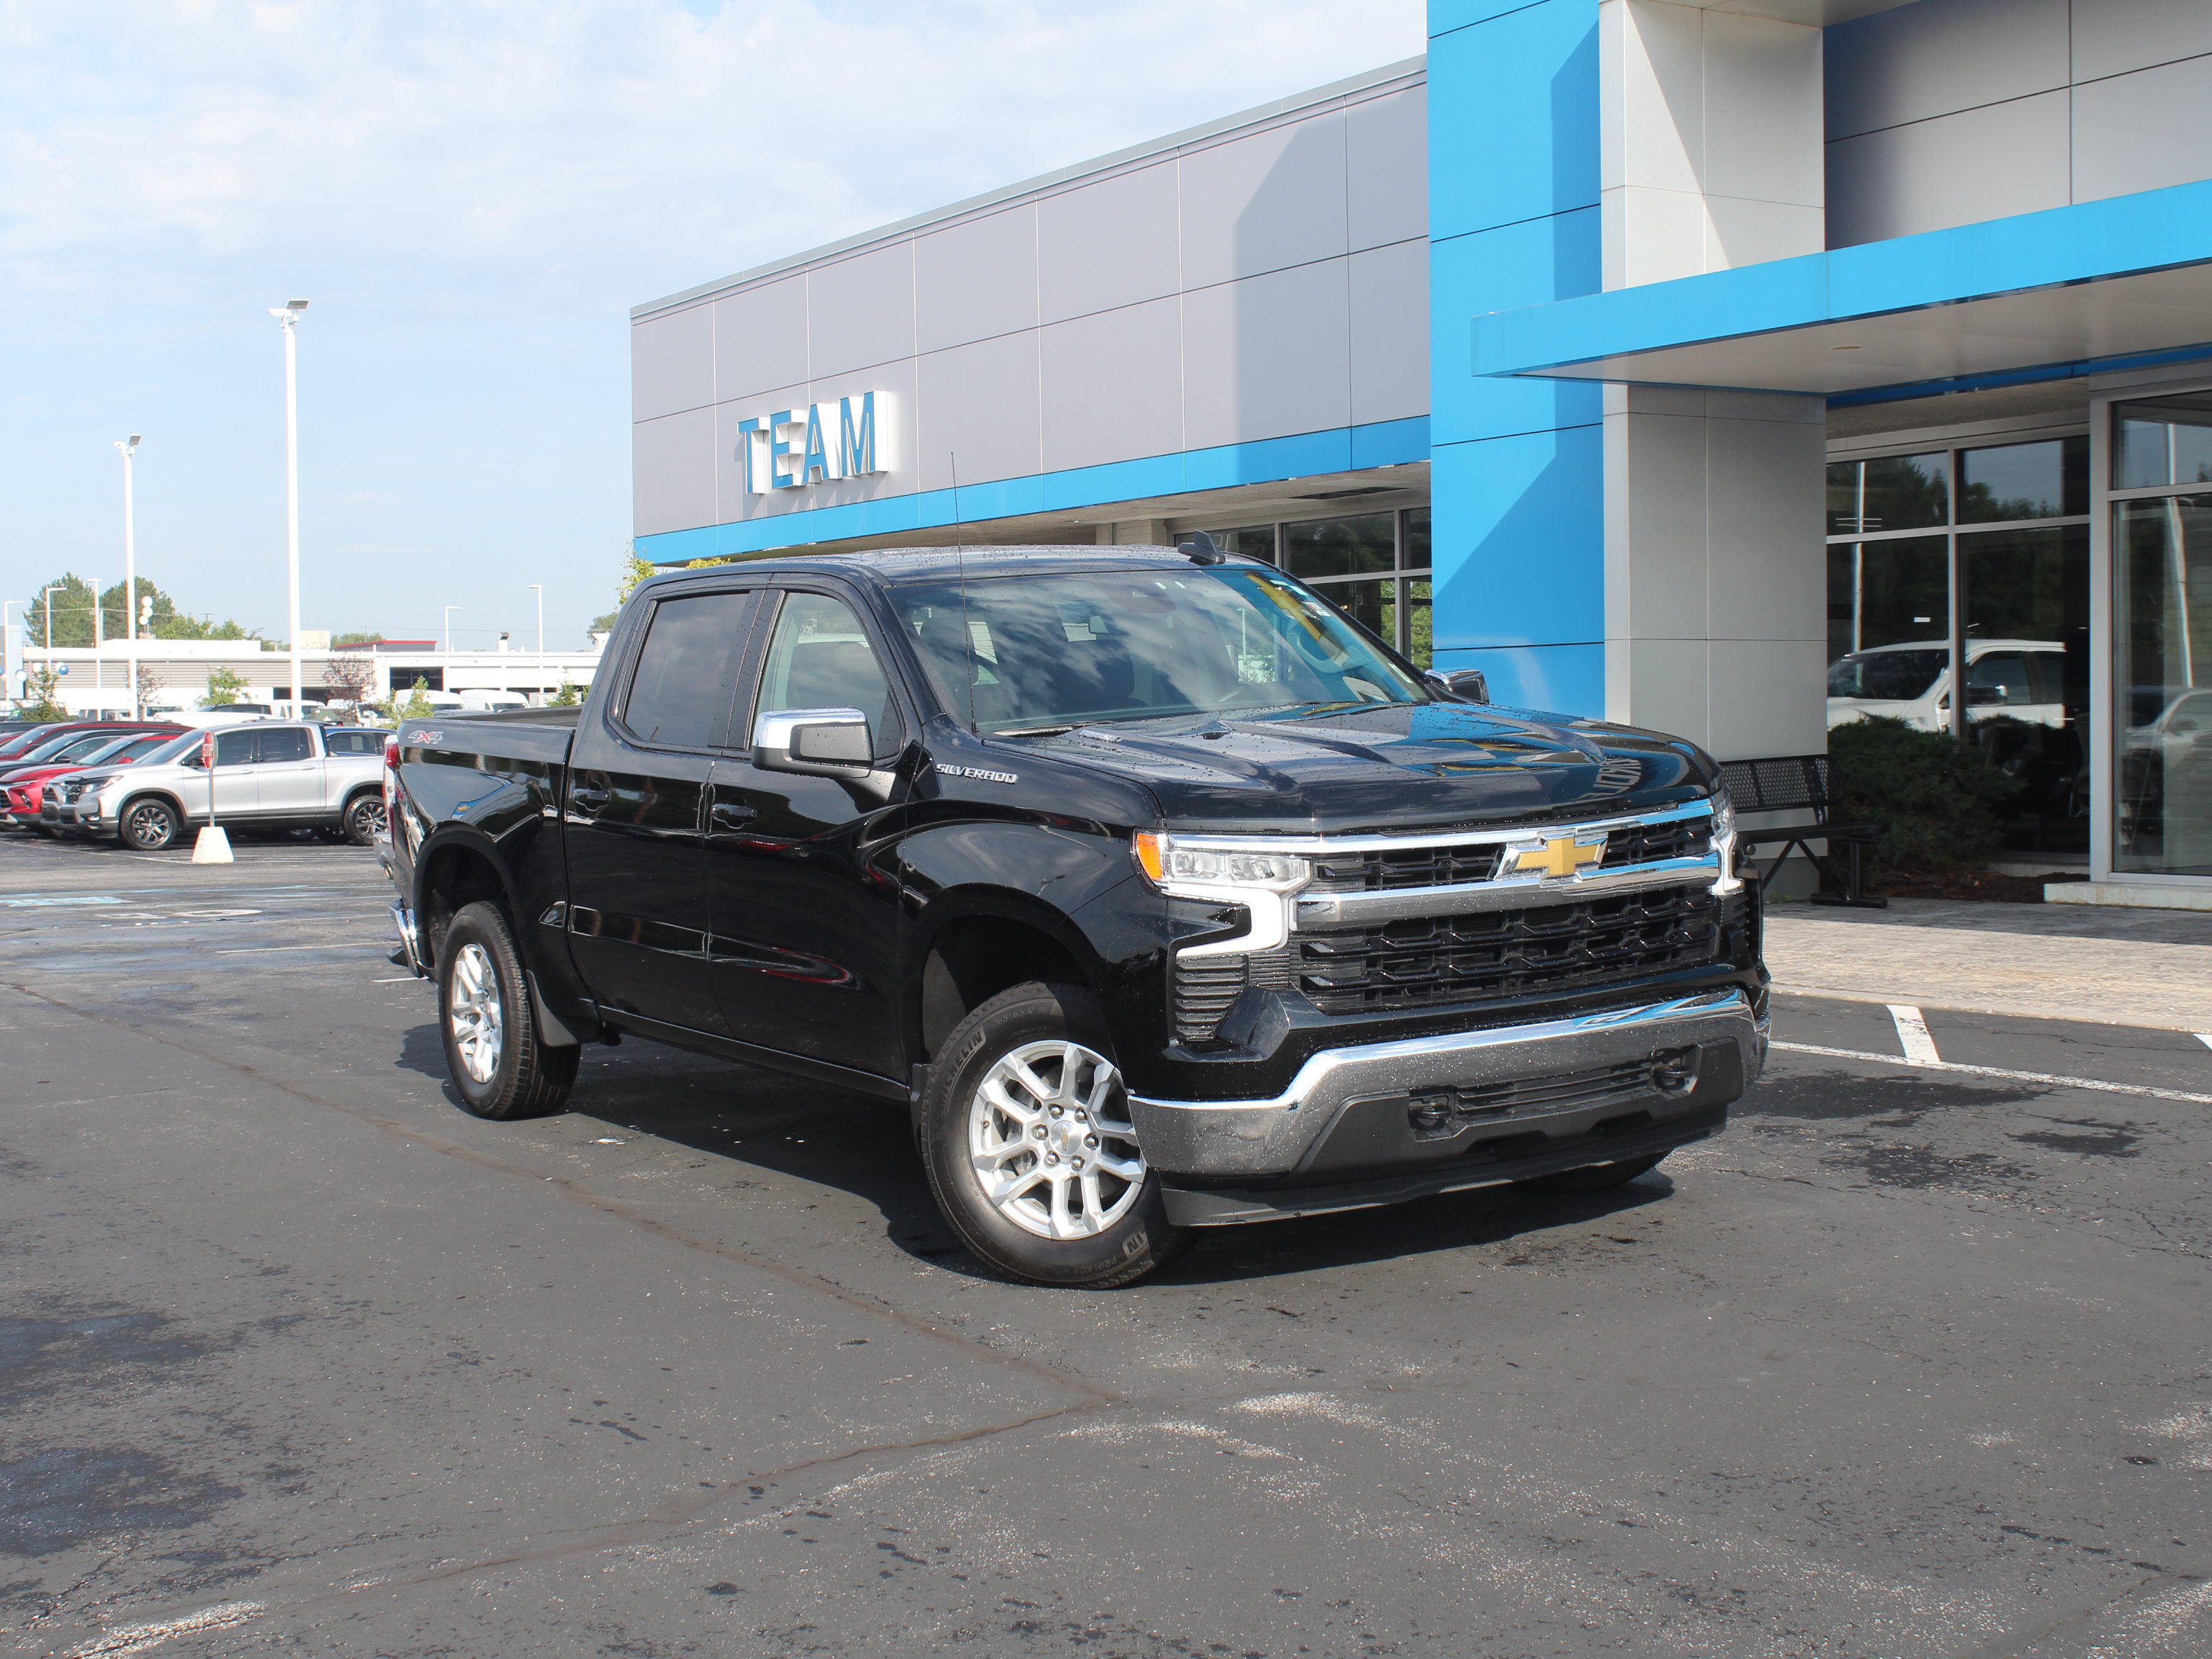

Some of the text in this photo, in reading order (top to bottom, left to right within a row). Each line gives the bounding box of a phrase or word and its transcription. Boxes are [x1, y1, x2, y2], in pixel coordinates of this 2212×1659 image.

[737, 391, 887, 495] TEAM
[202, 743, 213, 757] STOP
[936, 763, 1019, 784] SILVERADO
[938, 1030, 982, 1107] MICHELIN
